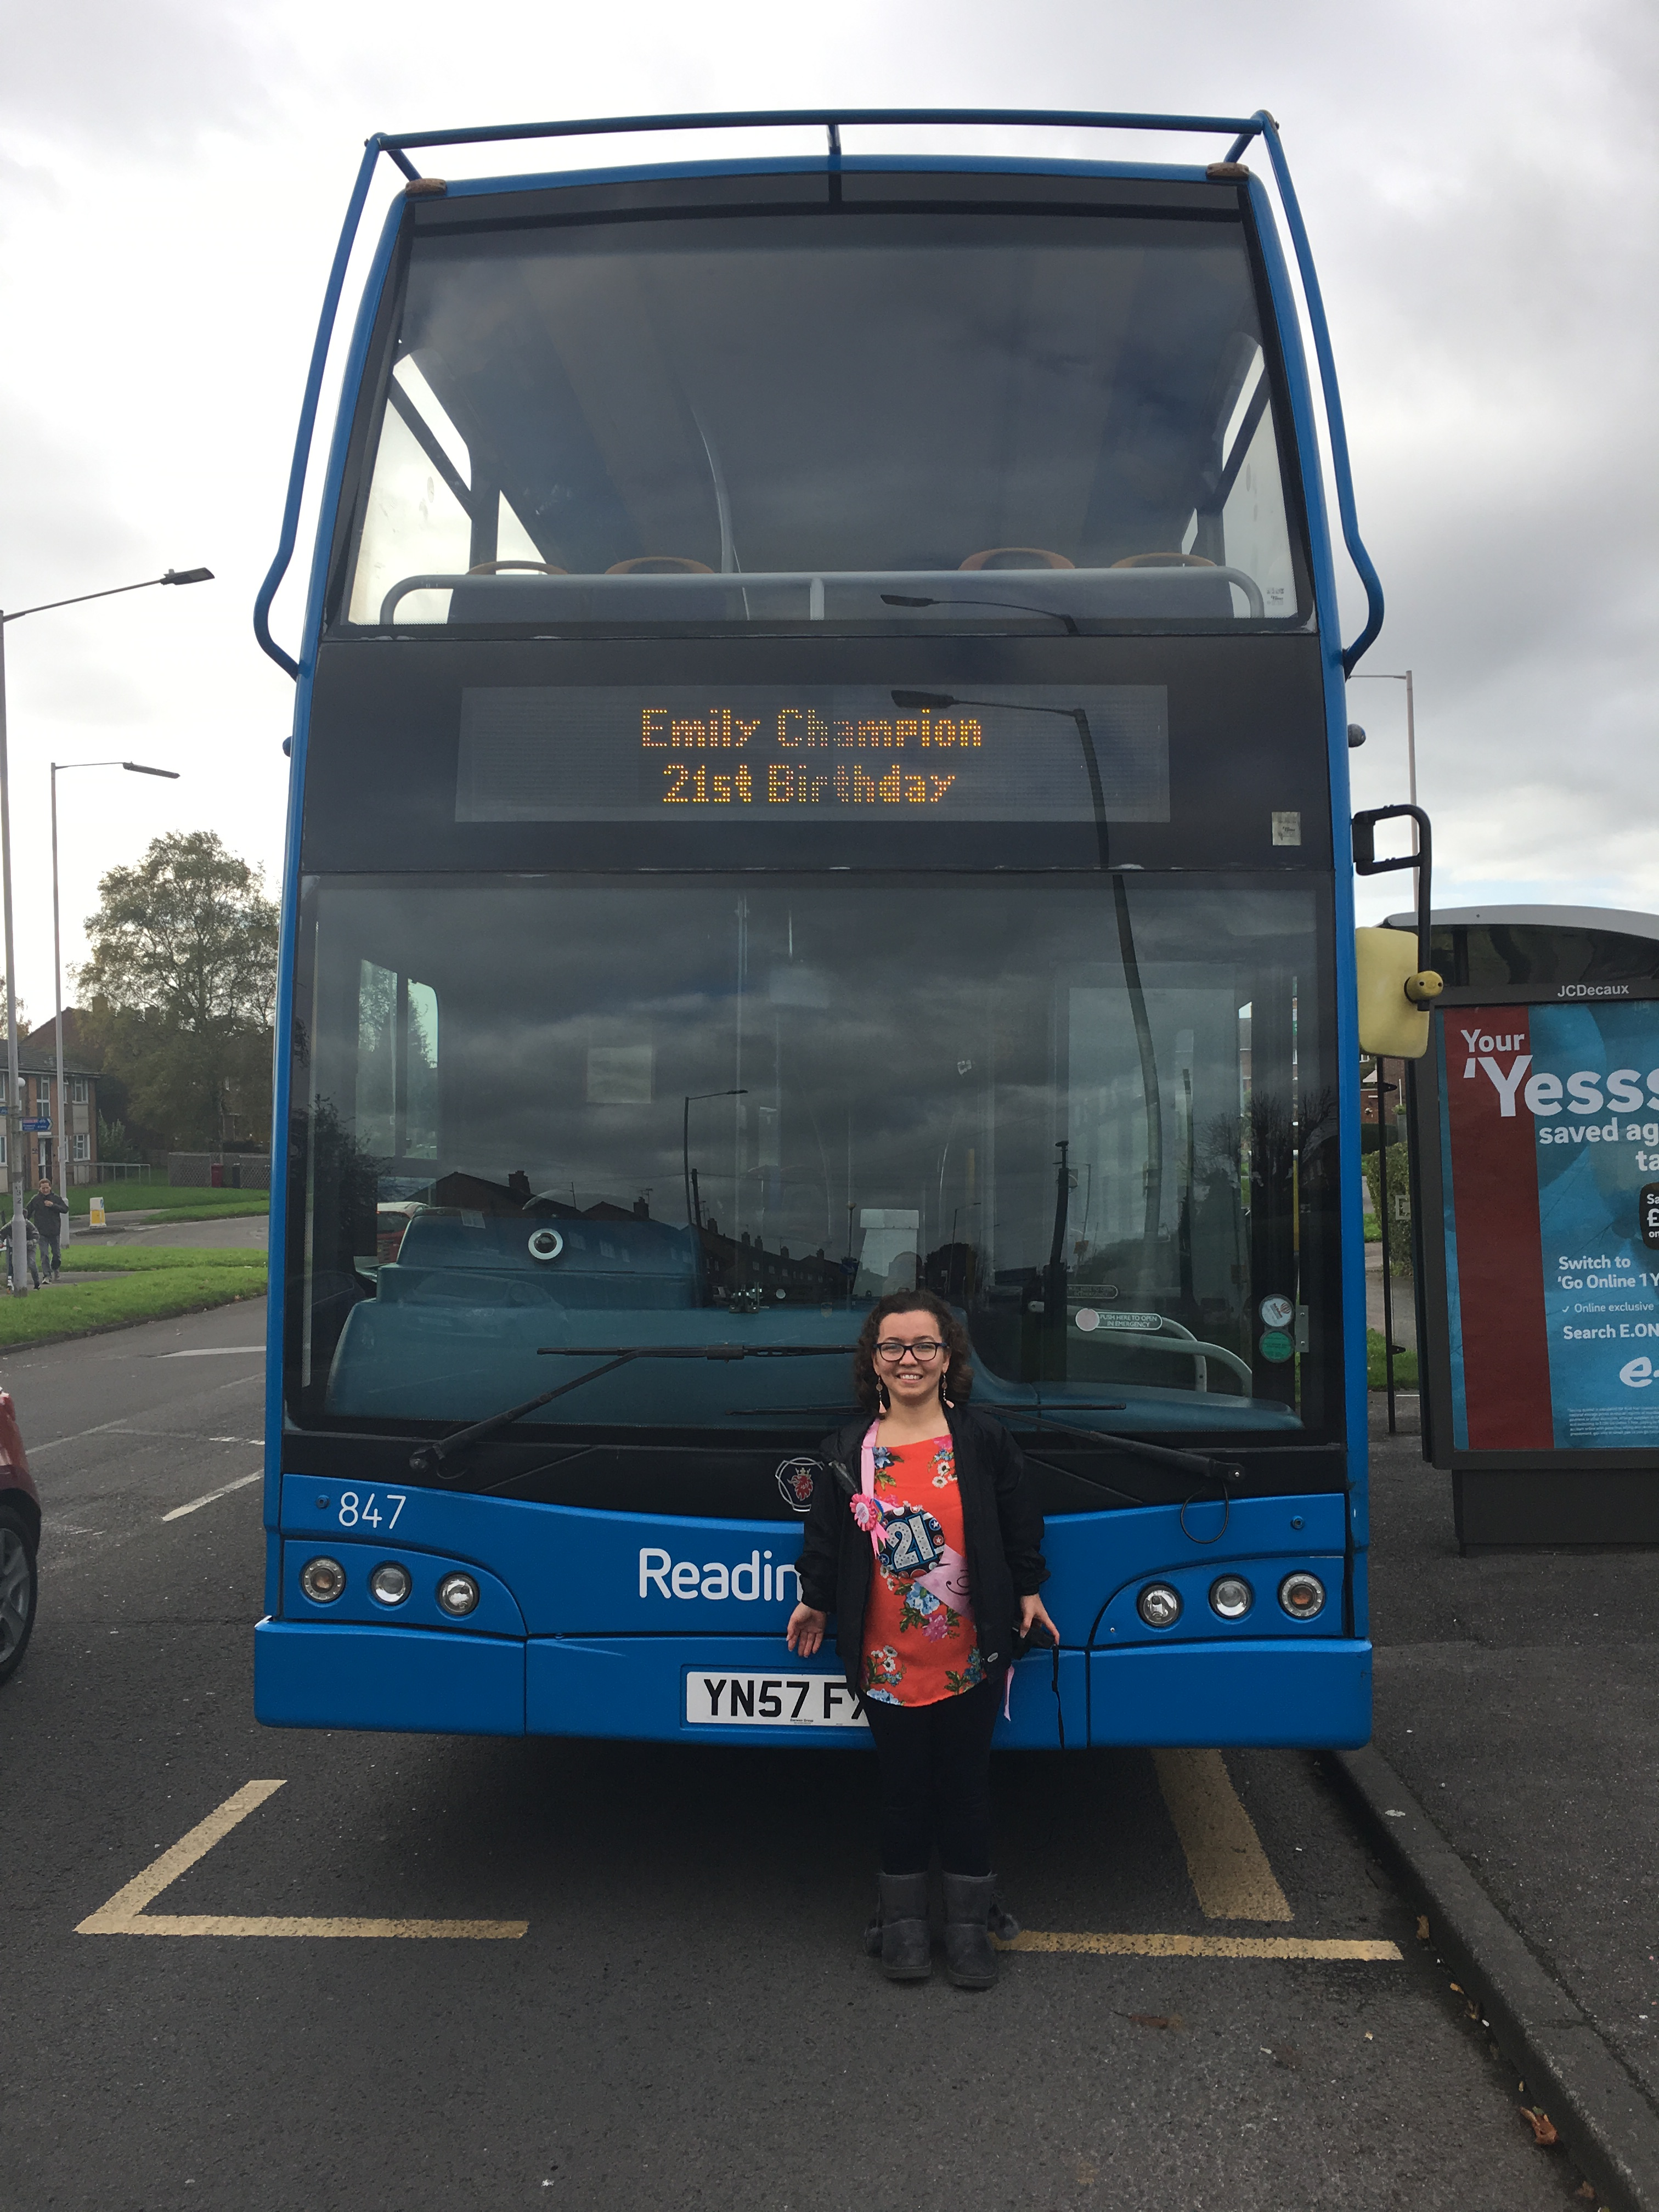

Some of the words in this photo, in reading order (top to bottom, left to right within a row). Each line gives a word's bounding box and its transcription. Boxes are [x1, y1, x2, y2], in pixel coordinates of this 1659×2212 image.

[642, 709, 760, 747] Emily
[777, 709, 982, 747] Champion
[663, 765, 752, 803] 21st
[768, 765, 956, 803] Birthday
[1557, 985, 1629, 997] JCDecaux
[1461, 1029, 1525, 1053] Your
[1539, 1117, 1618, 1144] saved
[1559, 1254, 1611, 1270] Switch
[1614, 1256, 1631, 1268] to
[1587, 1274, 1636, 1288] Online
[1639, 1273, 1647, 1286] 1
[1574, 1303, 1606, 1313] Online
[1609, 1301, 1654, 1312] exclusive
[1564, 1324, 1616, 1340] Search
[338, 1491, 407, 1530] 847
[884, 1513, 936, 1571] 21
[704, 1678, 810, 1718] YN57
